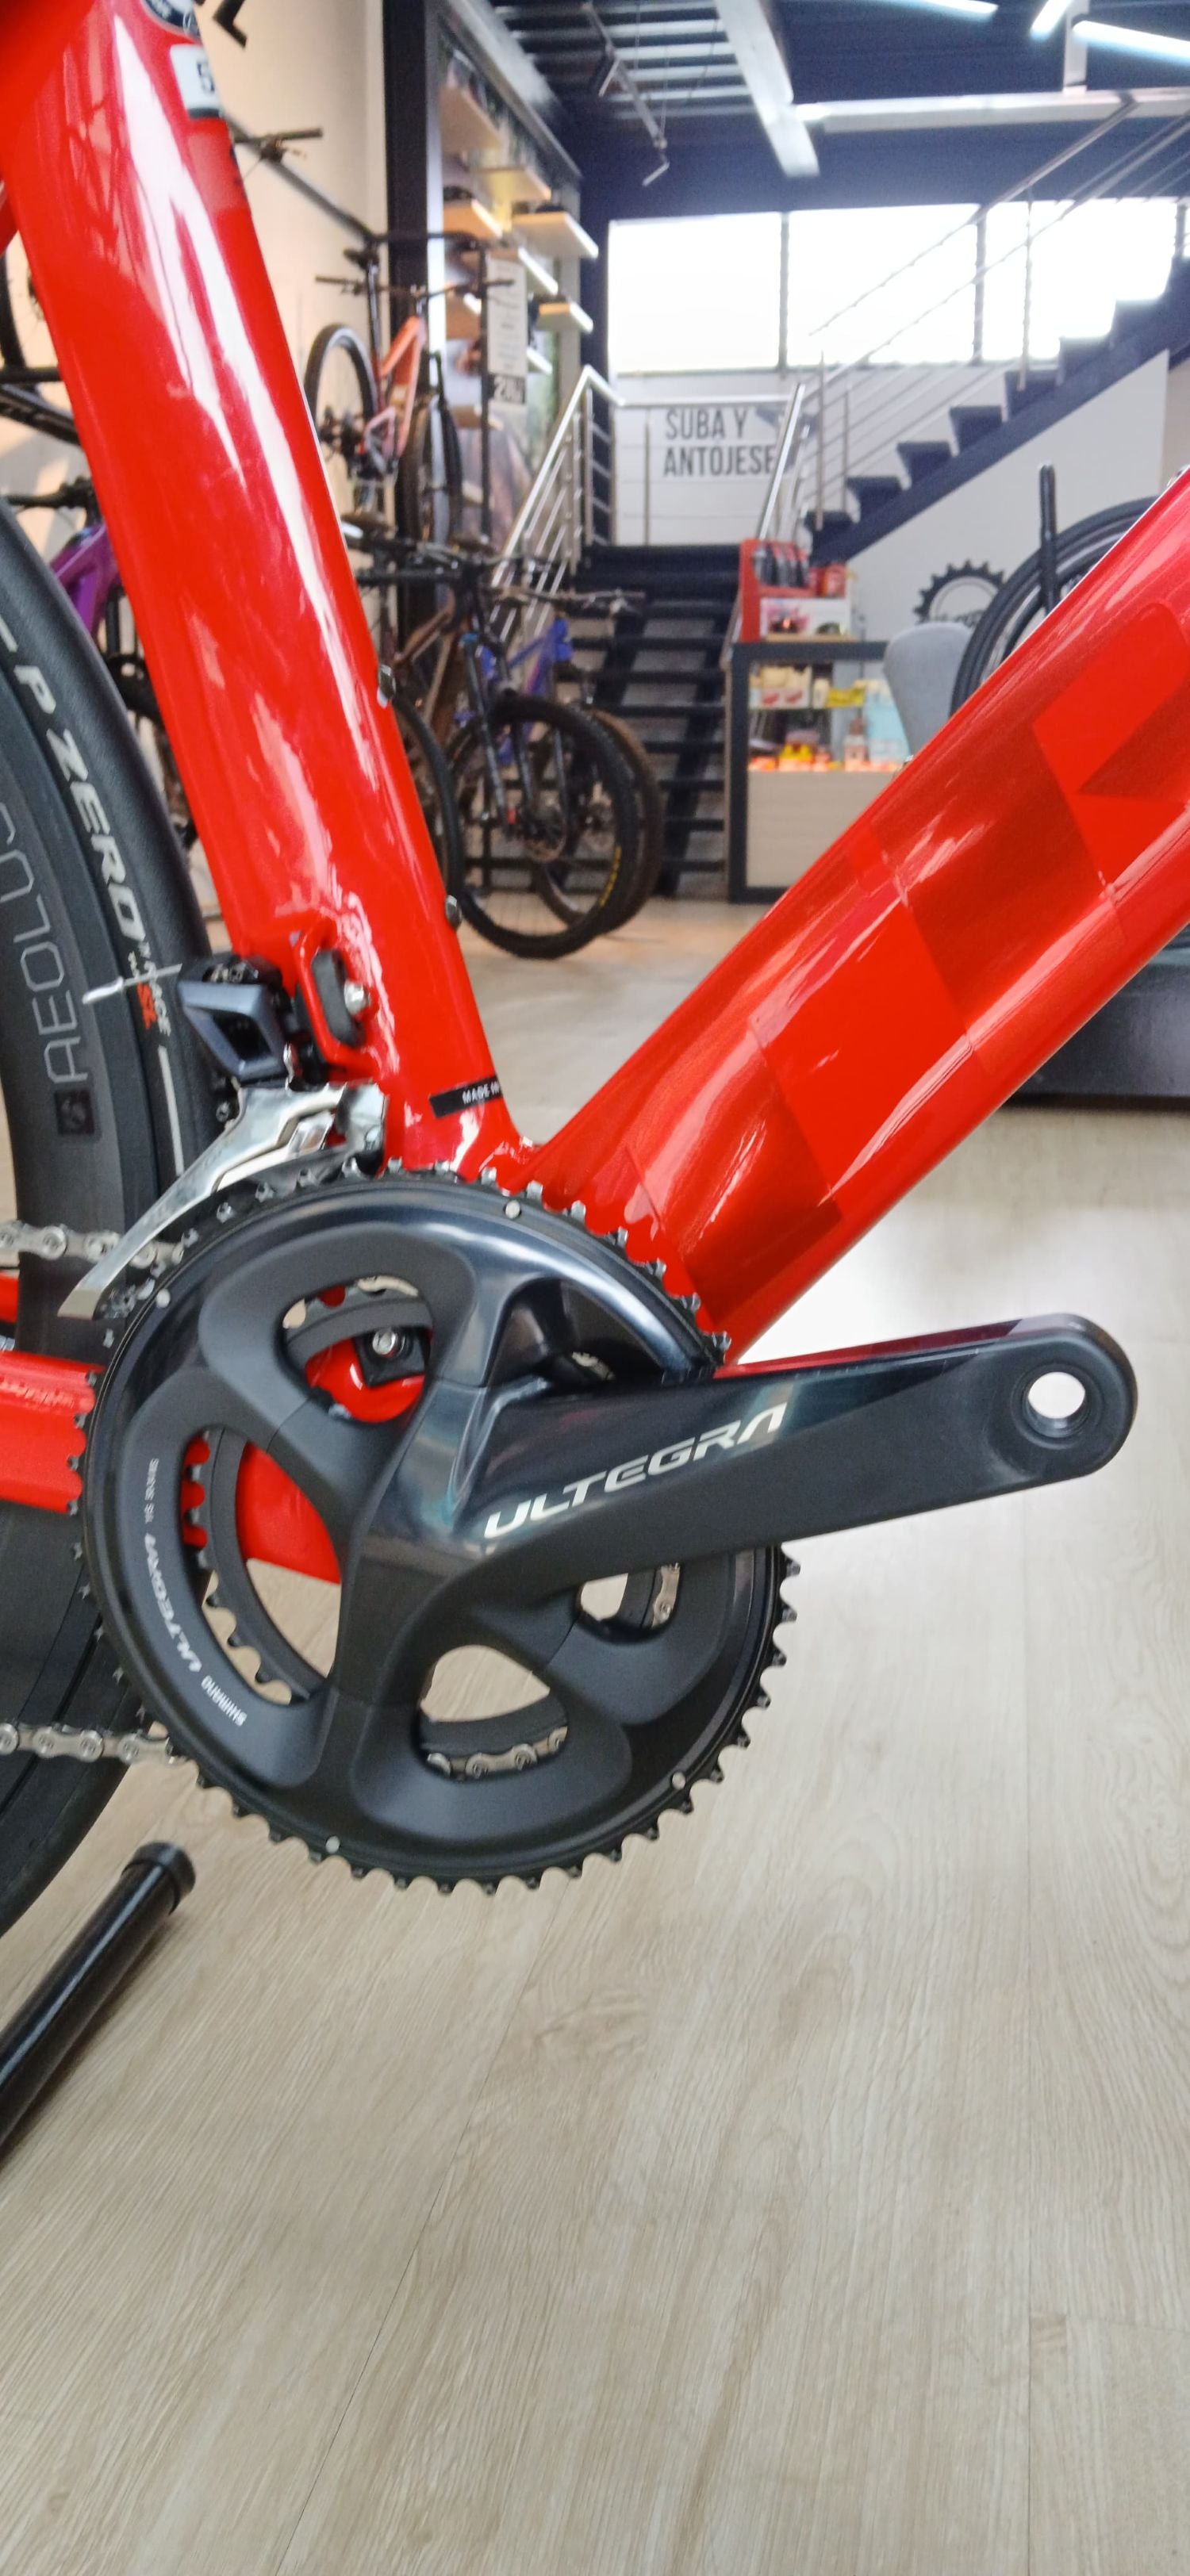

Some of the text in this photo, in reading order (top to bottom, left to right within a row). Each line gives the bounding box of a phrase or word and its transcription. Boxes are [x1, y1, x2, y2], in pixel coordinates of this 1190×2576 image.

[666, 407, 748, 440] SUBA Y
[484, 1401, 788, 1539] ULTEGRA
[144, 1532, 202, 1673] ULTEGRA
[201, 1675, 248, 1727] SHIMANO
